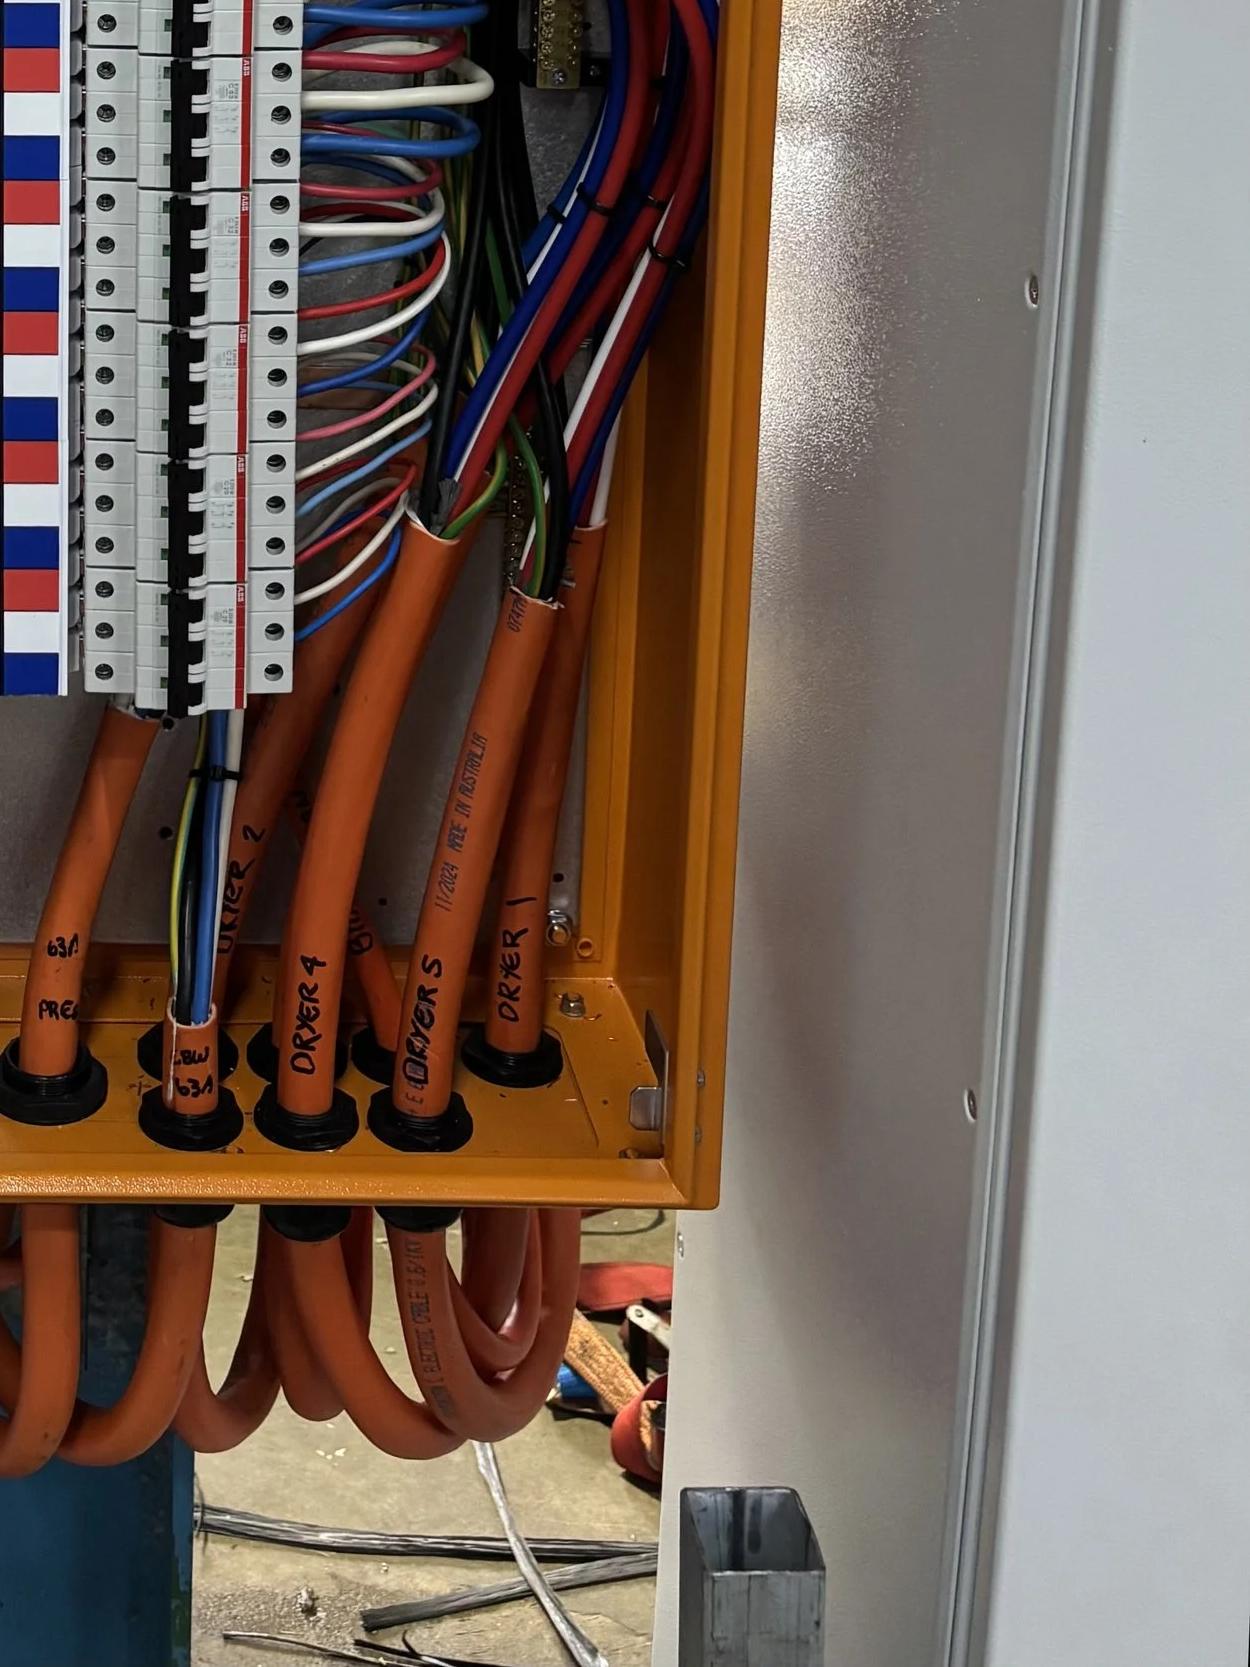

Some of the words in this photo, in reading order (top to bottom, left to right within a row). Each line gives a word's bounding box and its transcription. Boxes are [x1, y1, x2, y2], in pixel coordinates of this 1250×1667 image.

[242, 59, 251, 76] ABB
[241, 195, 249, 212] ABB
[239, 327, 247, 343] ABB
[456, 731, 487, 800] AUSTRALIA
[452, 803, 472, 818] IN
[242, 824, 266, 844] 2
[446, 824, 469, 853] MADE
[434, 864, 460, 912] 11/2024
[299, 955, 327, 978] 4
[497, 927, 529, 1022] DRYER
[291, 984, 320, 1075] DRYER
[402, 987, 440, 1085] DRYER
[175, 1074, 214, 1098] 63A
[408, 1292, 432, 1324] CABLE
